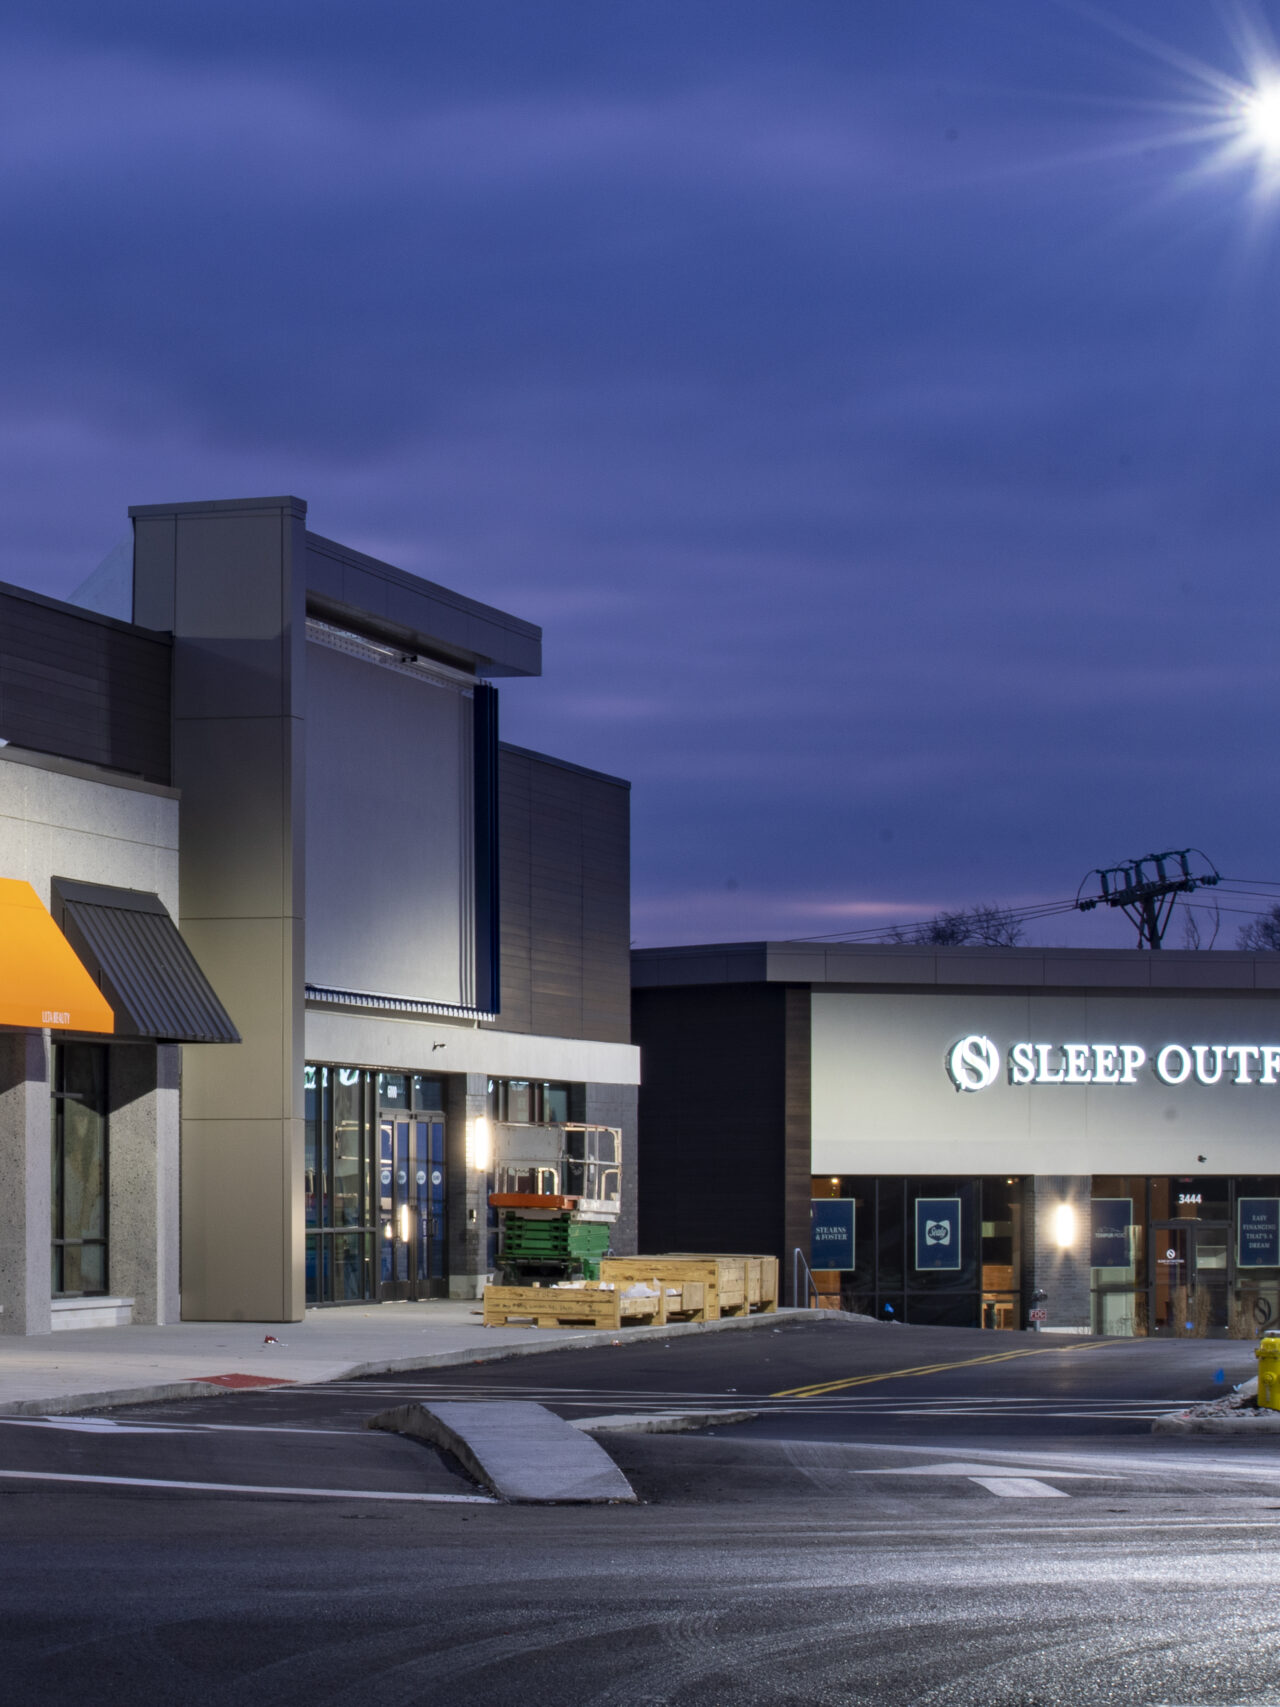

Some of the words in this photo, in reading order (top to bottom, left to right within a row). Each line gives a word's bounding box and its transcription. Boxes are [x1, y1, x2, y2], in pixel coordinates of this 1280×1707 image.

[1011, 1043, 1146, 1084] SLEEP
[1178, 1194, 1202, 1204] 3444
[928, 1226, 947, 1239] Sealy
